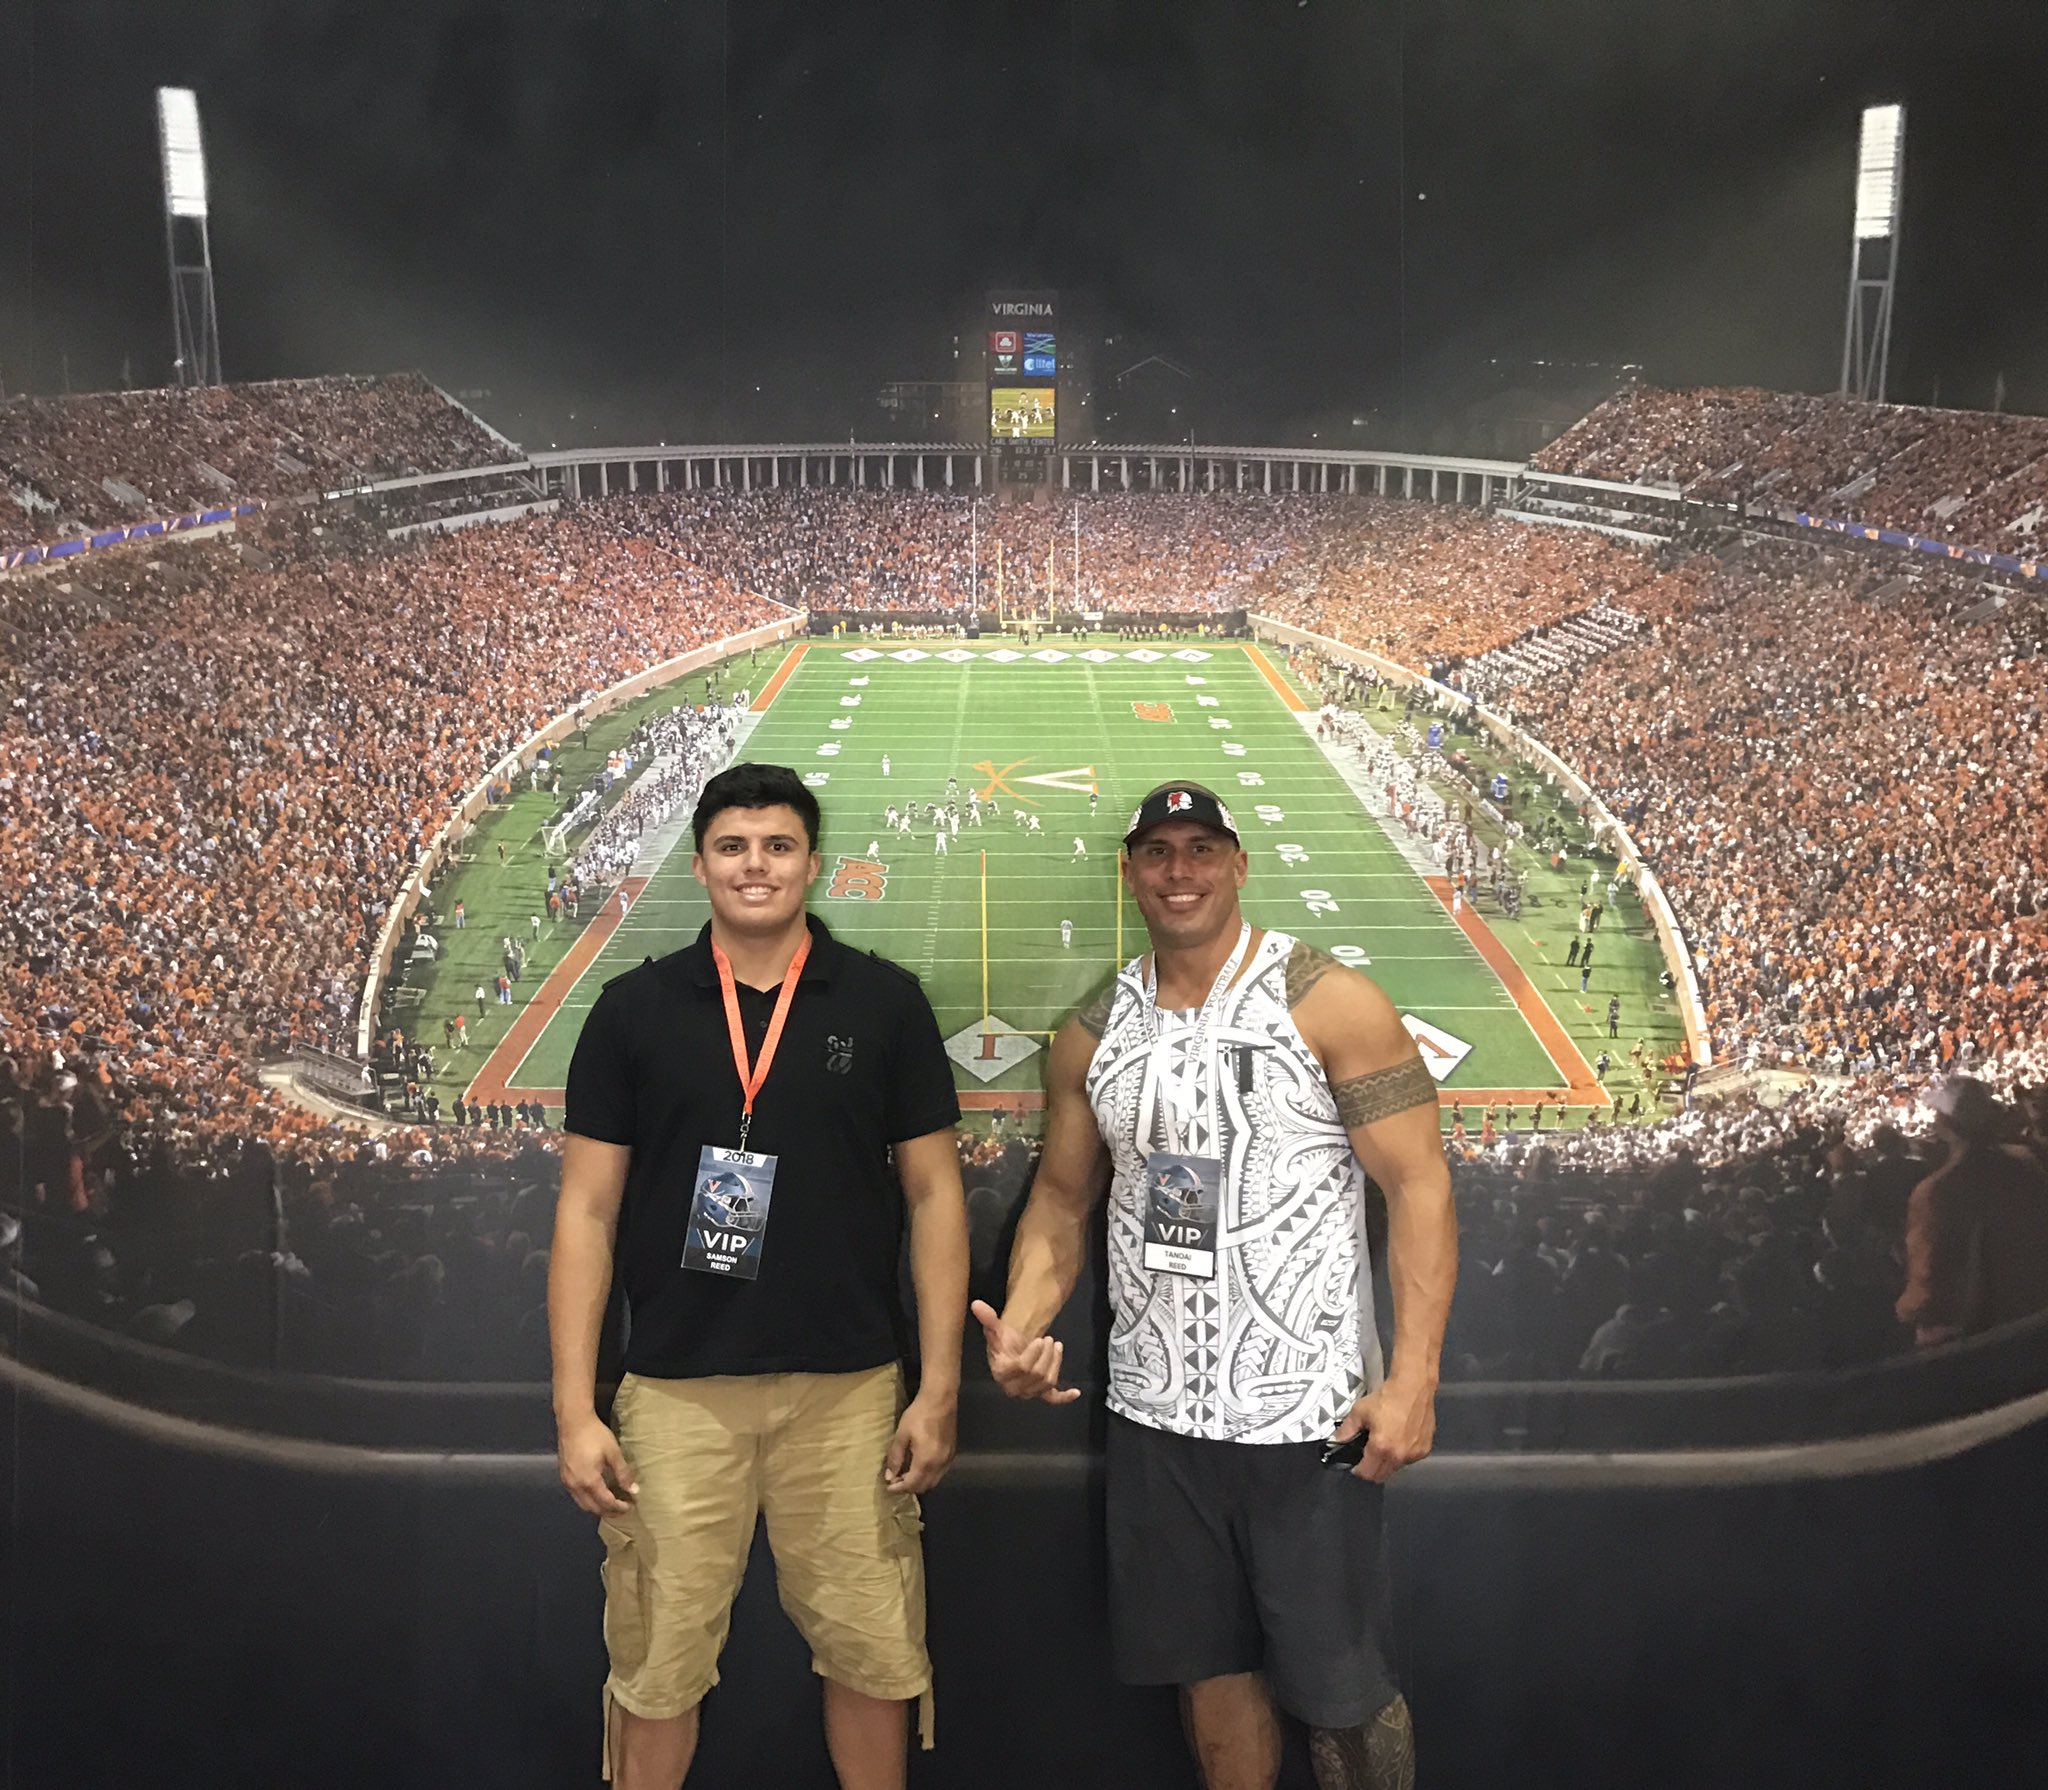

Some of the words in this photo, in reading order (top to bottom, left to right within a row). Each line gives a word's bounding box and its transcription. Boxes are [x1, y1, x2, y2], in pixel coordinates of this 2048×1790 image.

[992, 303, 1053, 316] VIRGINIA
[1236, 771, 1265, 786] 50
[1254, 804, 1285, 822] 40
[1275, 843, 1310, 862] 30
[826, 855, 890, 901] ACC
[1300, 889, 1340, 912] 20
[1187, 1009, 1211, 1065] VIRGINIA
[1205, 957, 1241, 1010] FOOTBALL
[723, 1150, 754, 1165] 2018
[703, 1230, 747, 1253] VIP
[1158, 1223, 1202, 1245] VIP
[706, 1252, 738, 1264] SAMSON
[1164, 1250, 1192, 1261] TANOAI
[710, 1262, 731, 1271] REED
[1168, 1261, 1187, 1271] REED
